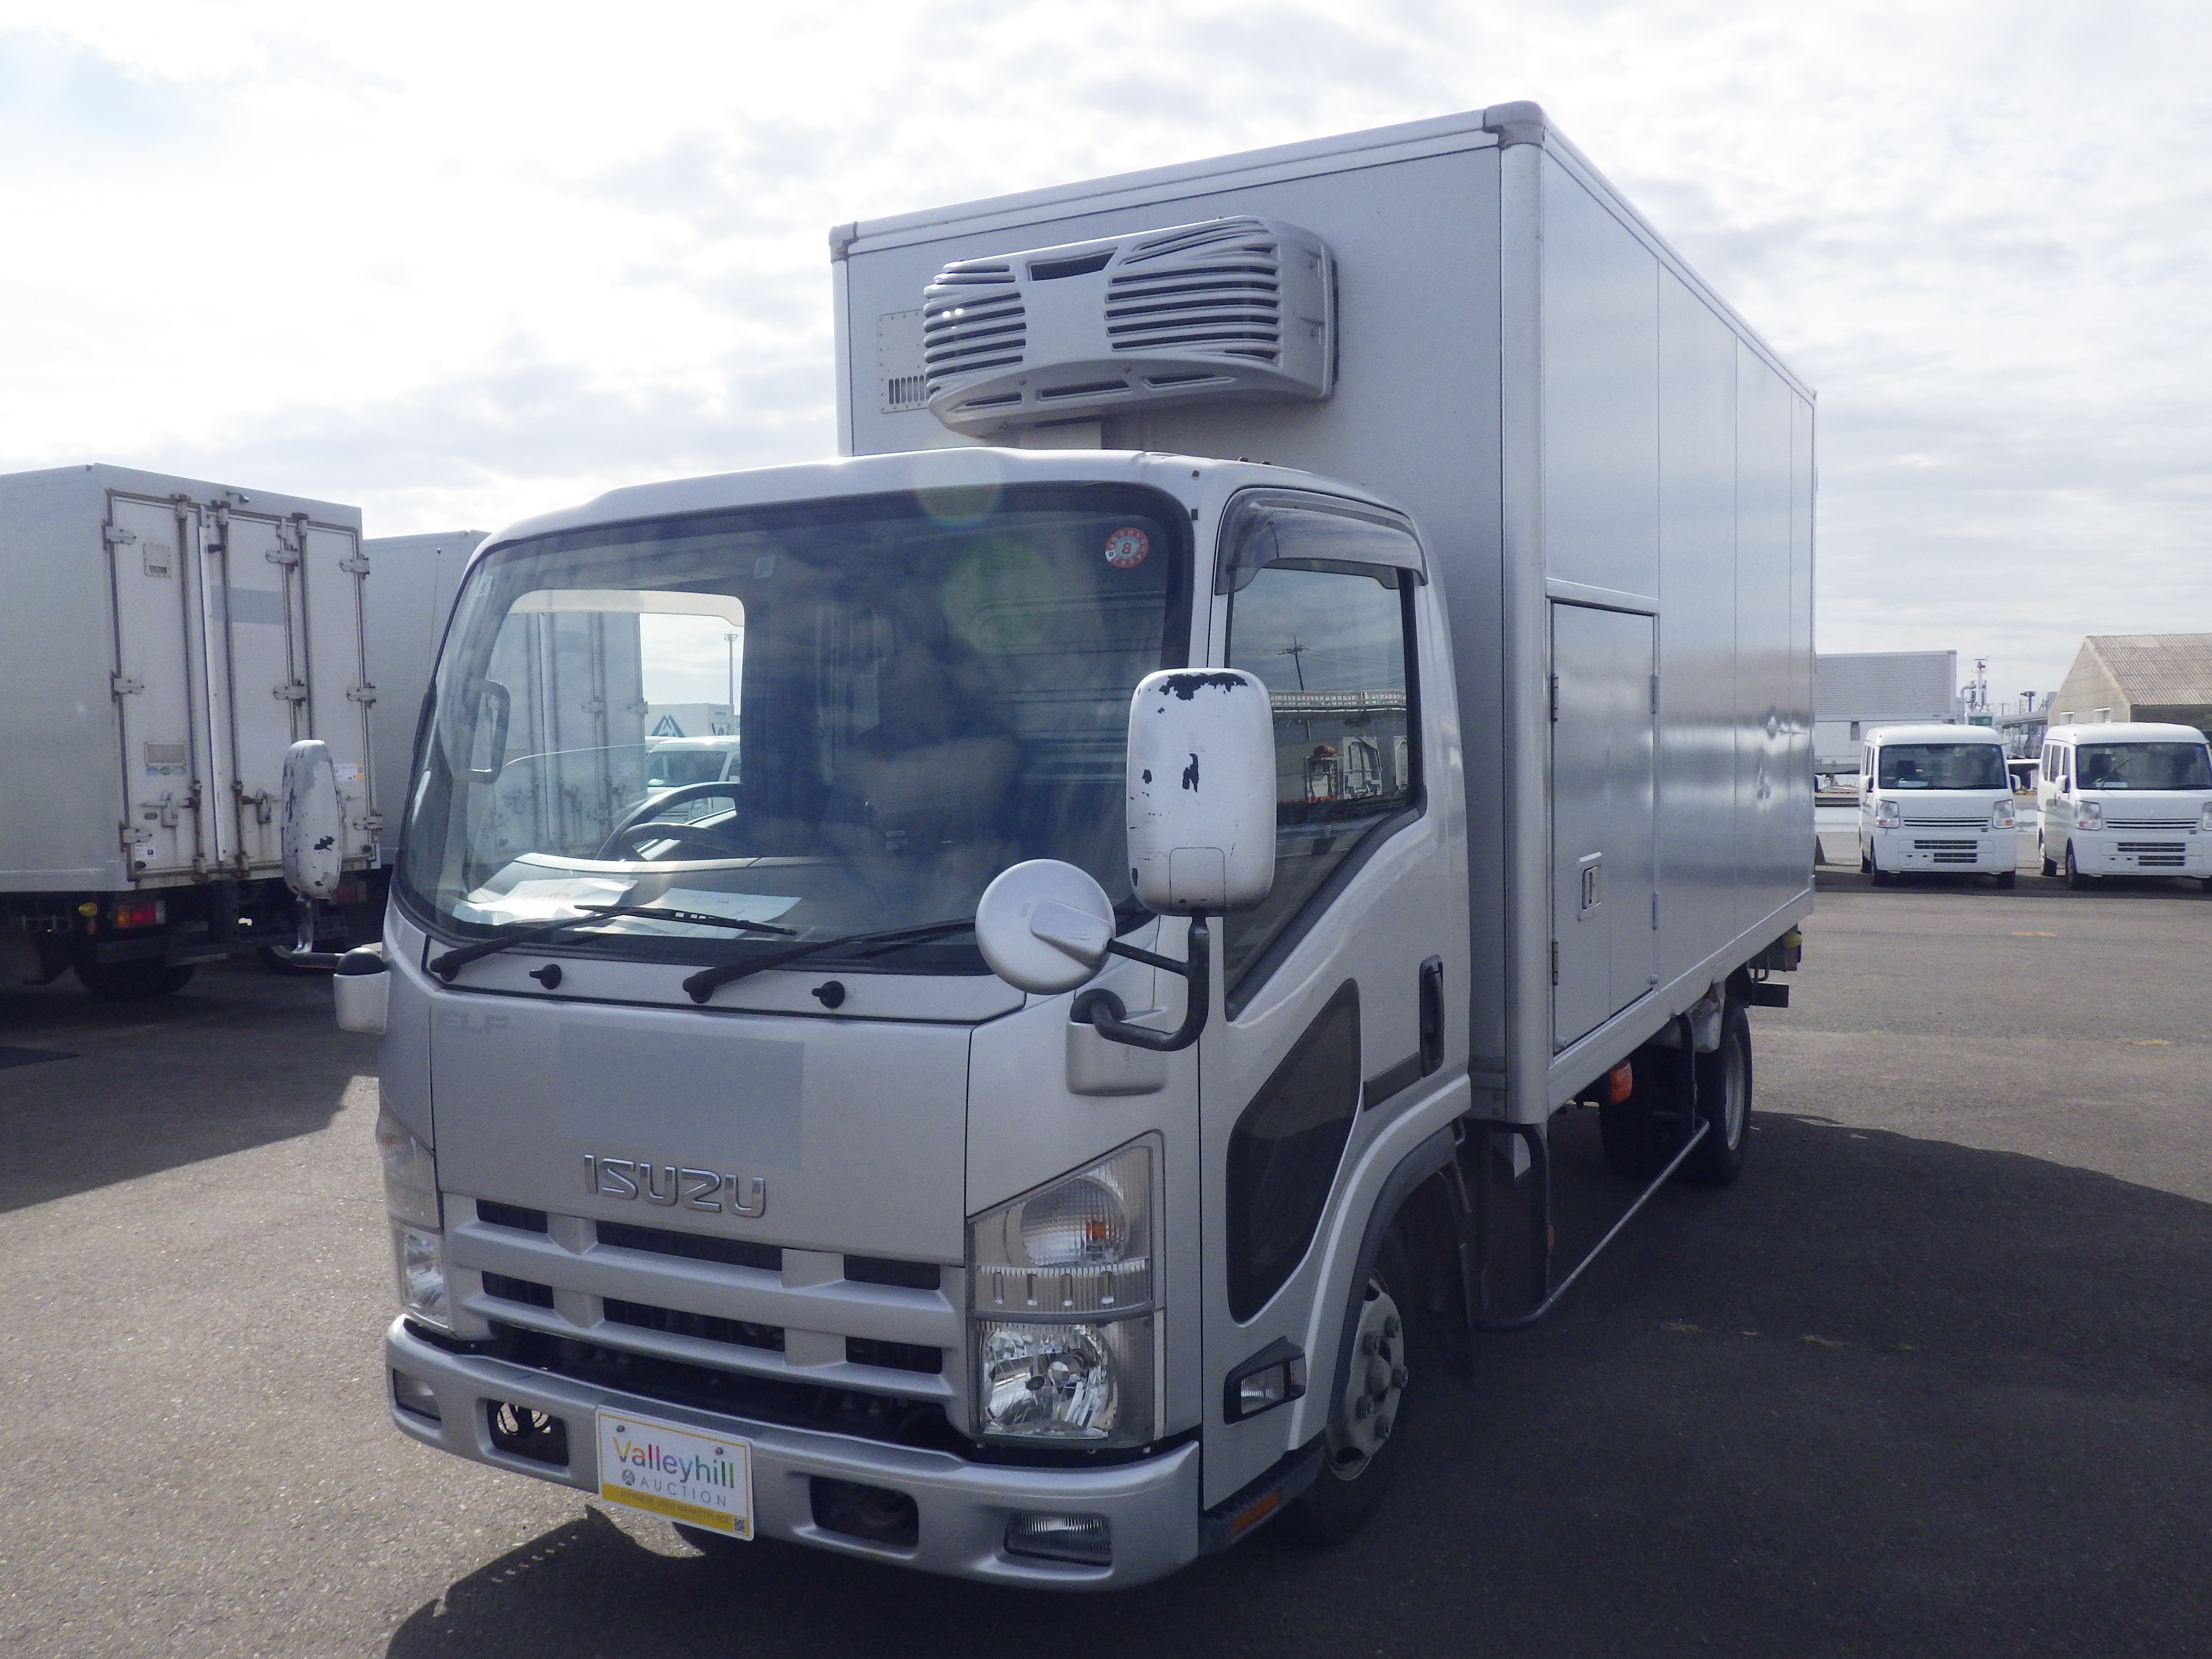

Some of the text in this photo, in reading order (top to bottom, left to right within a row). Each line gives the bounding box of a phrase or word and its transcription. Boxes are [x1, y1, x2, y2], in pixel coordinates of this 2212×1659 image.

[1122, 542, 1131, 554] 8
[584, 1154, 766, 1218] ISUZU
[613, 1437, 734, 1489] Valleyhill
[640, 1477, 726, 1507] AUCTION
